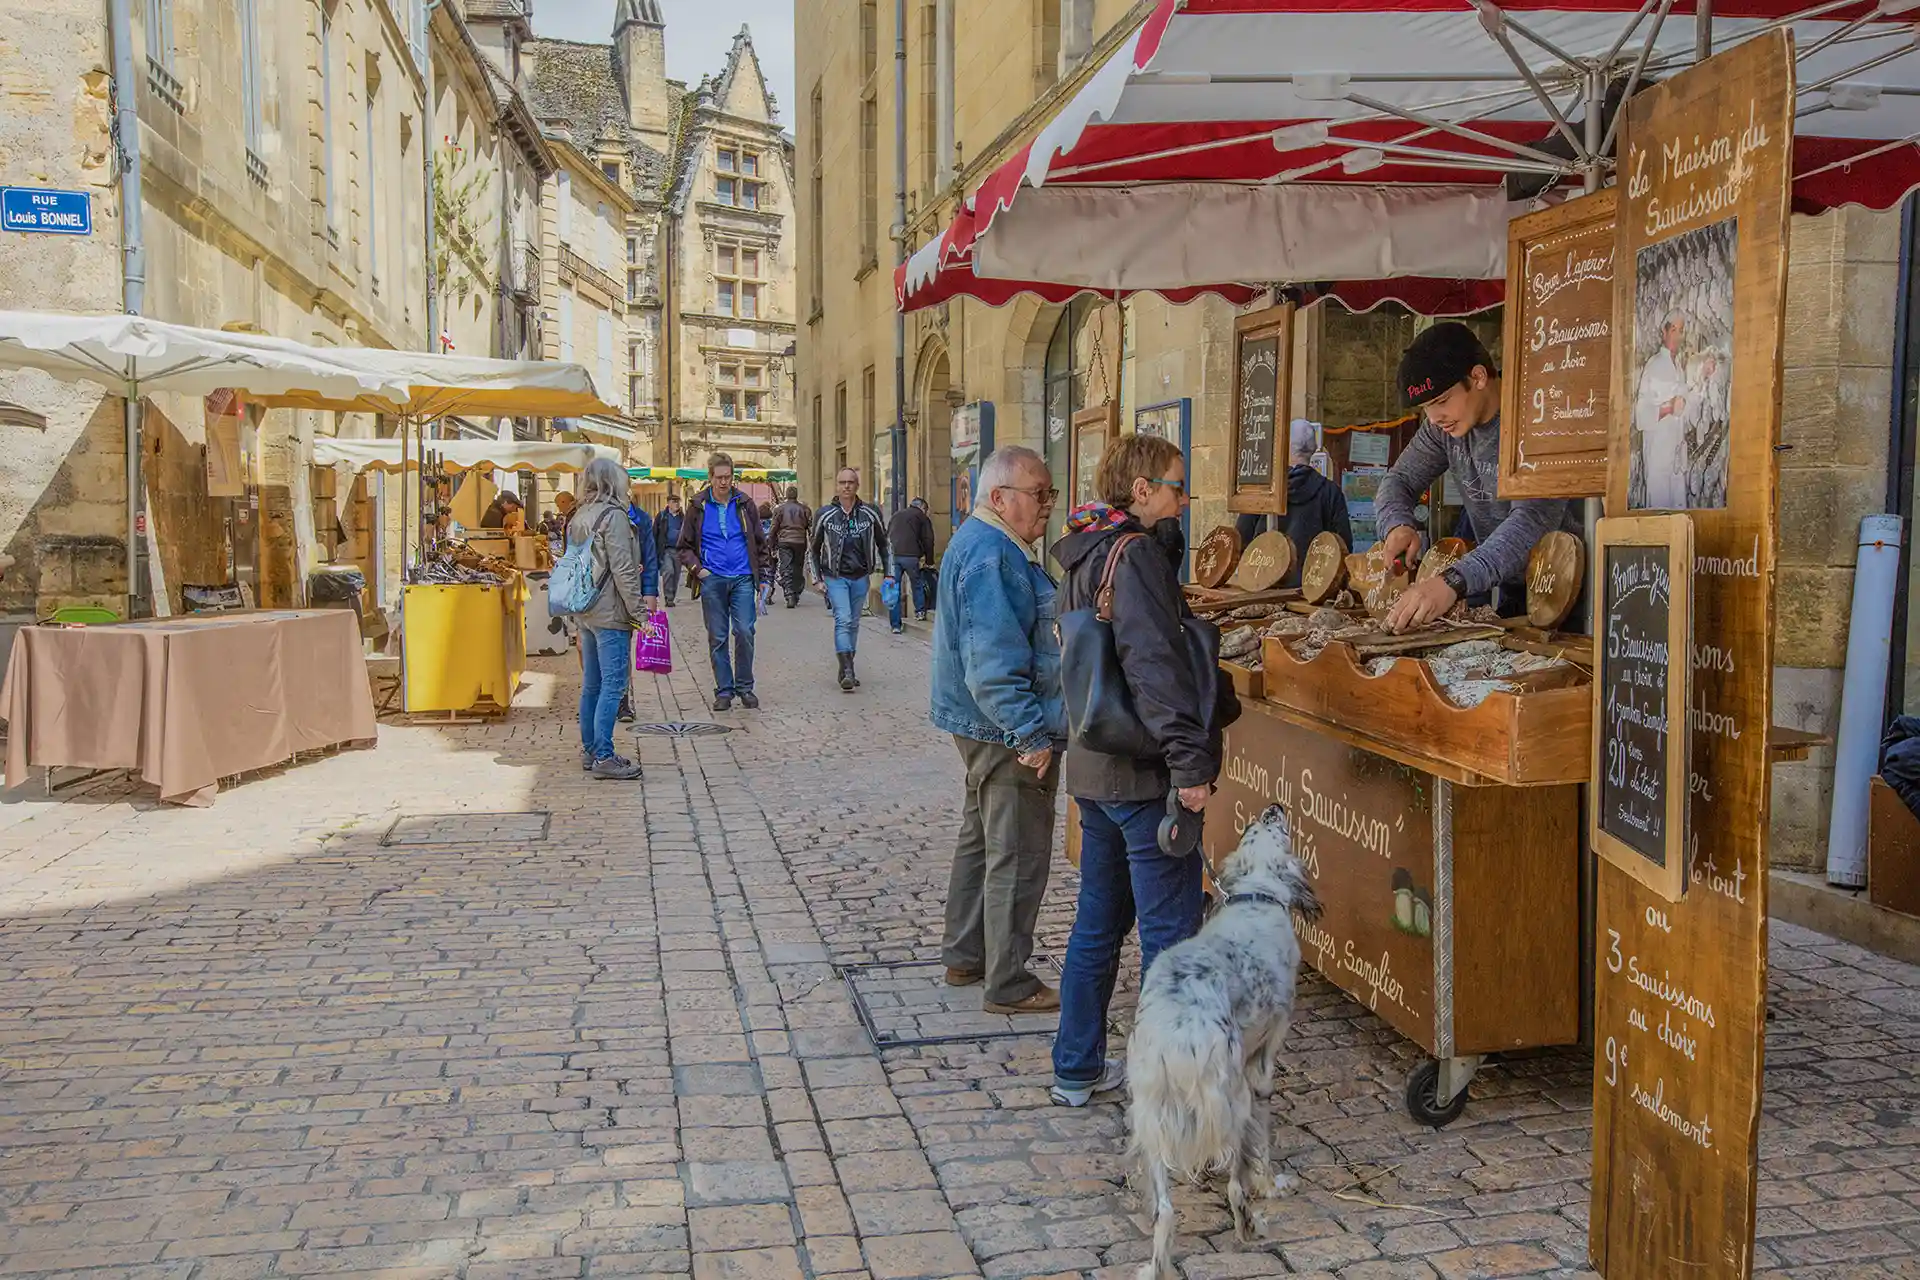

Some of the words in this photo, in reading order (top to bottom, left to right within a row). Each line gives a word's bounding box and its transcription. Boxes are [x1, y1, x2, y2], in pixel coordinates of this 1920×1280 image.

[1663, 135, 1731, 183] Maison
[1739, 98, 1771, 157] du
[9, 210, 37, 224] Louis
[41, 212, 84, 226] BONNEL
[32, 195, 58, 205] RUE
[1531, 316, 1546, 351] 3
[1548, 318, 1608, 346] Saucissons
[1541, 361, 1555, 373] au
[1560, 344, 1586, 370] choix
[1532, 388, 1545, 424] 9
[1612, 562, 1639, 598] Promo
[1641, 556, 1650, 581] du
[1609, 614, 1621, 658] 5
[1621, 624, 1668, 665] Saucissons
[1607, 684, 1616, 724] 1
[1276, 755, 1293, 809] du
[1608, 737, 1626, 789] 20
[1703, 852, 1746, 905] tout
[1645, 906, 1671, 933] ou
[1606, 928, 1622, 973] 3
[1626, 956, 1716, 1029] Saucissons
[1627, 1008, 1648, 1032] au
[1657, 1010, 1696, 1060] choix
